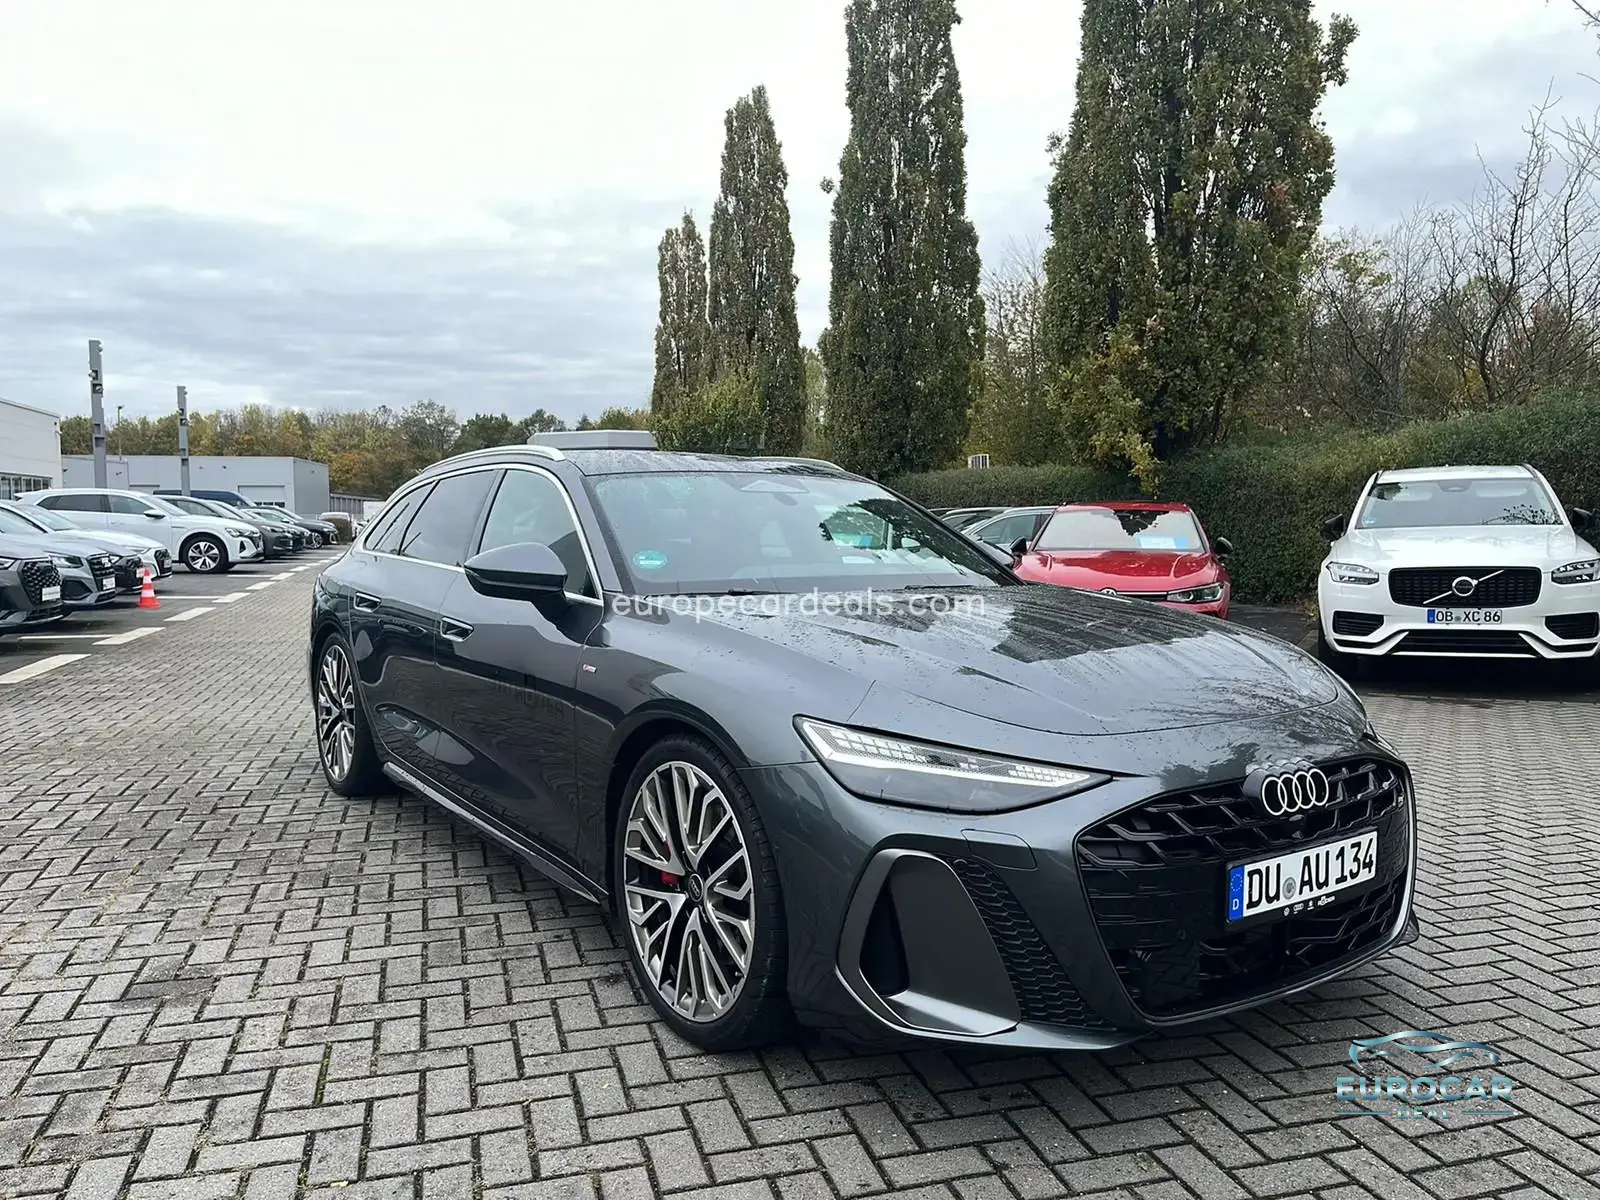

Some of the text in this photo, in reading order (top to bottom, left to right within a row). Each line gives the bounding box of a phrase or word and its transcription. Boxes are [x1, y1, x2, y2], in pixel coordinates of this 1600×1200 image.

[1436, 611, 1501, 622] OB XC 86
[1246, 838, 1374, 910] DU AU 134
[1232, 898, 1240, 911] D
